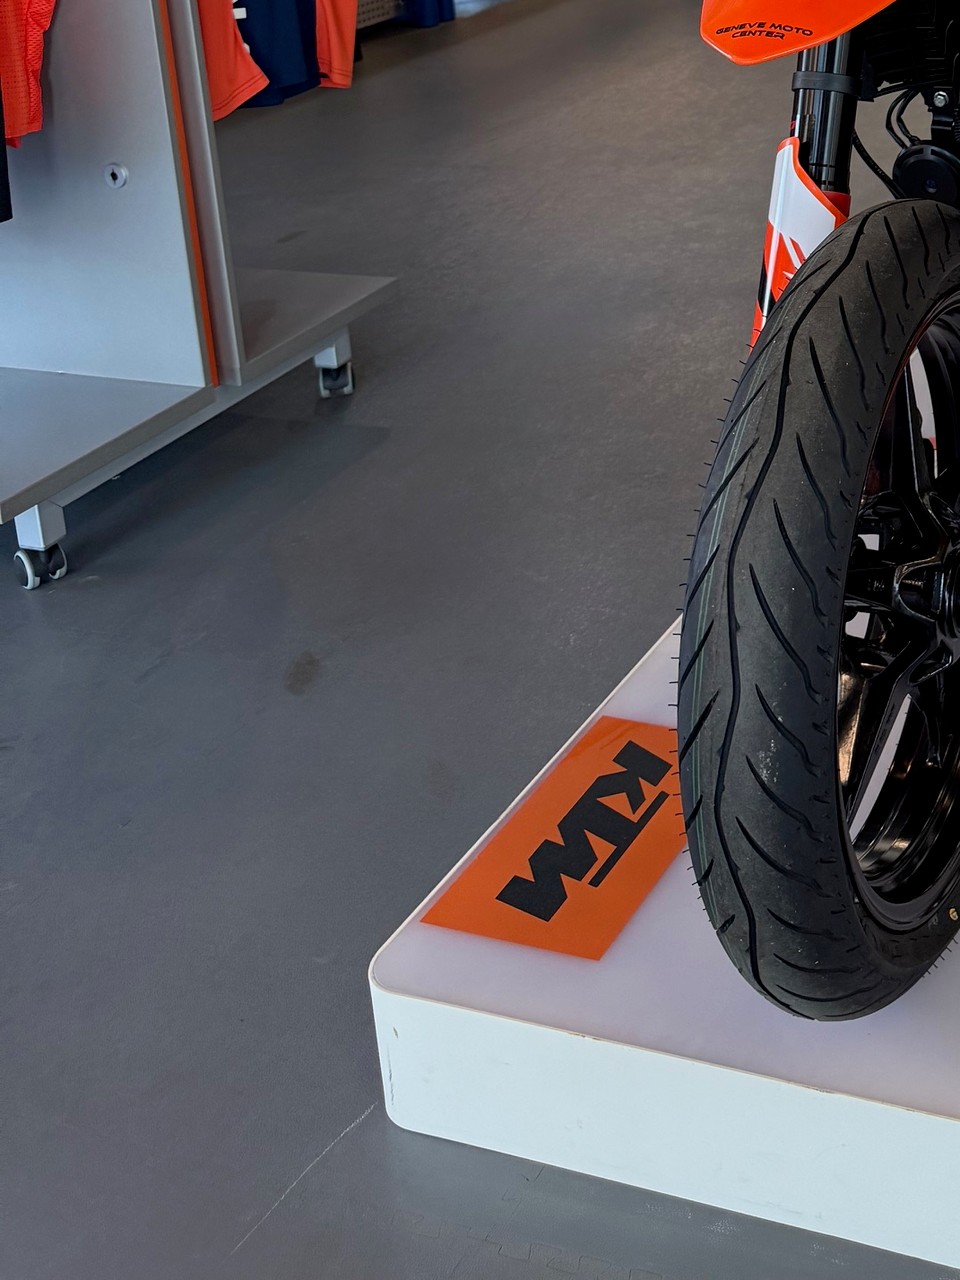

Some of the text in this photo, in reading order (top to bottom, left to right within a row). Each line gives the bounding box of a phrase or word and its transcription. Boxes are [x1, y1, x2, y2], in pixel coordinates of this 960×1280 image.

[715, 21, 814, 37] GENEVE MOTO
[731, 29, 786, 40] CENTER
[495, 739, 673, 923] KTM
